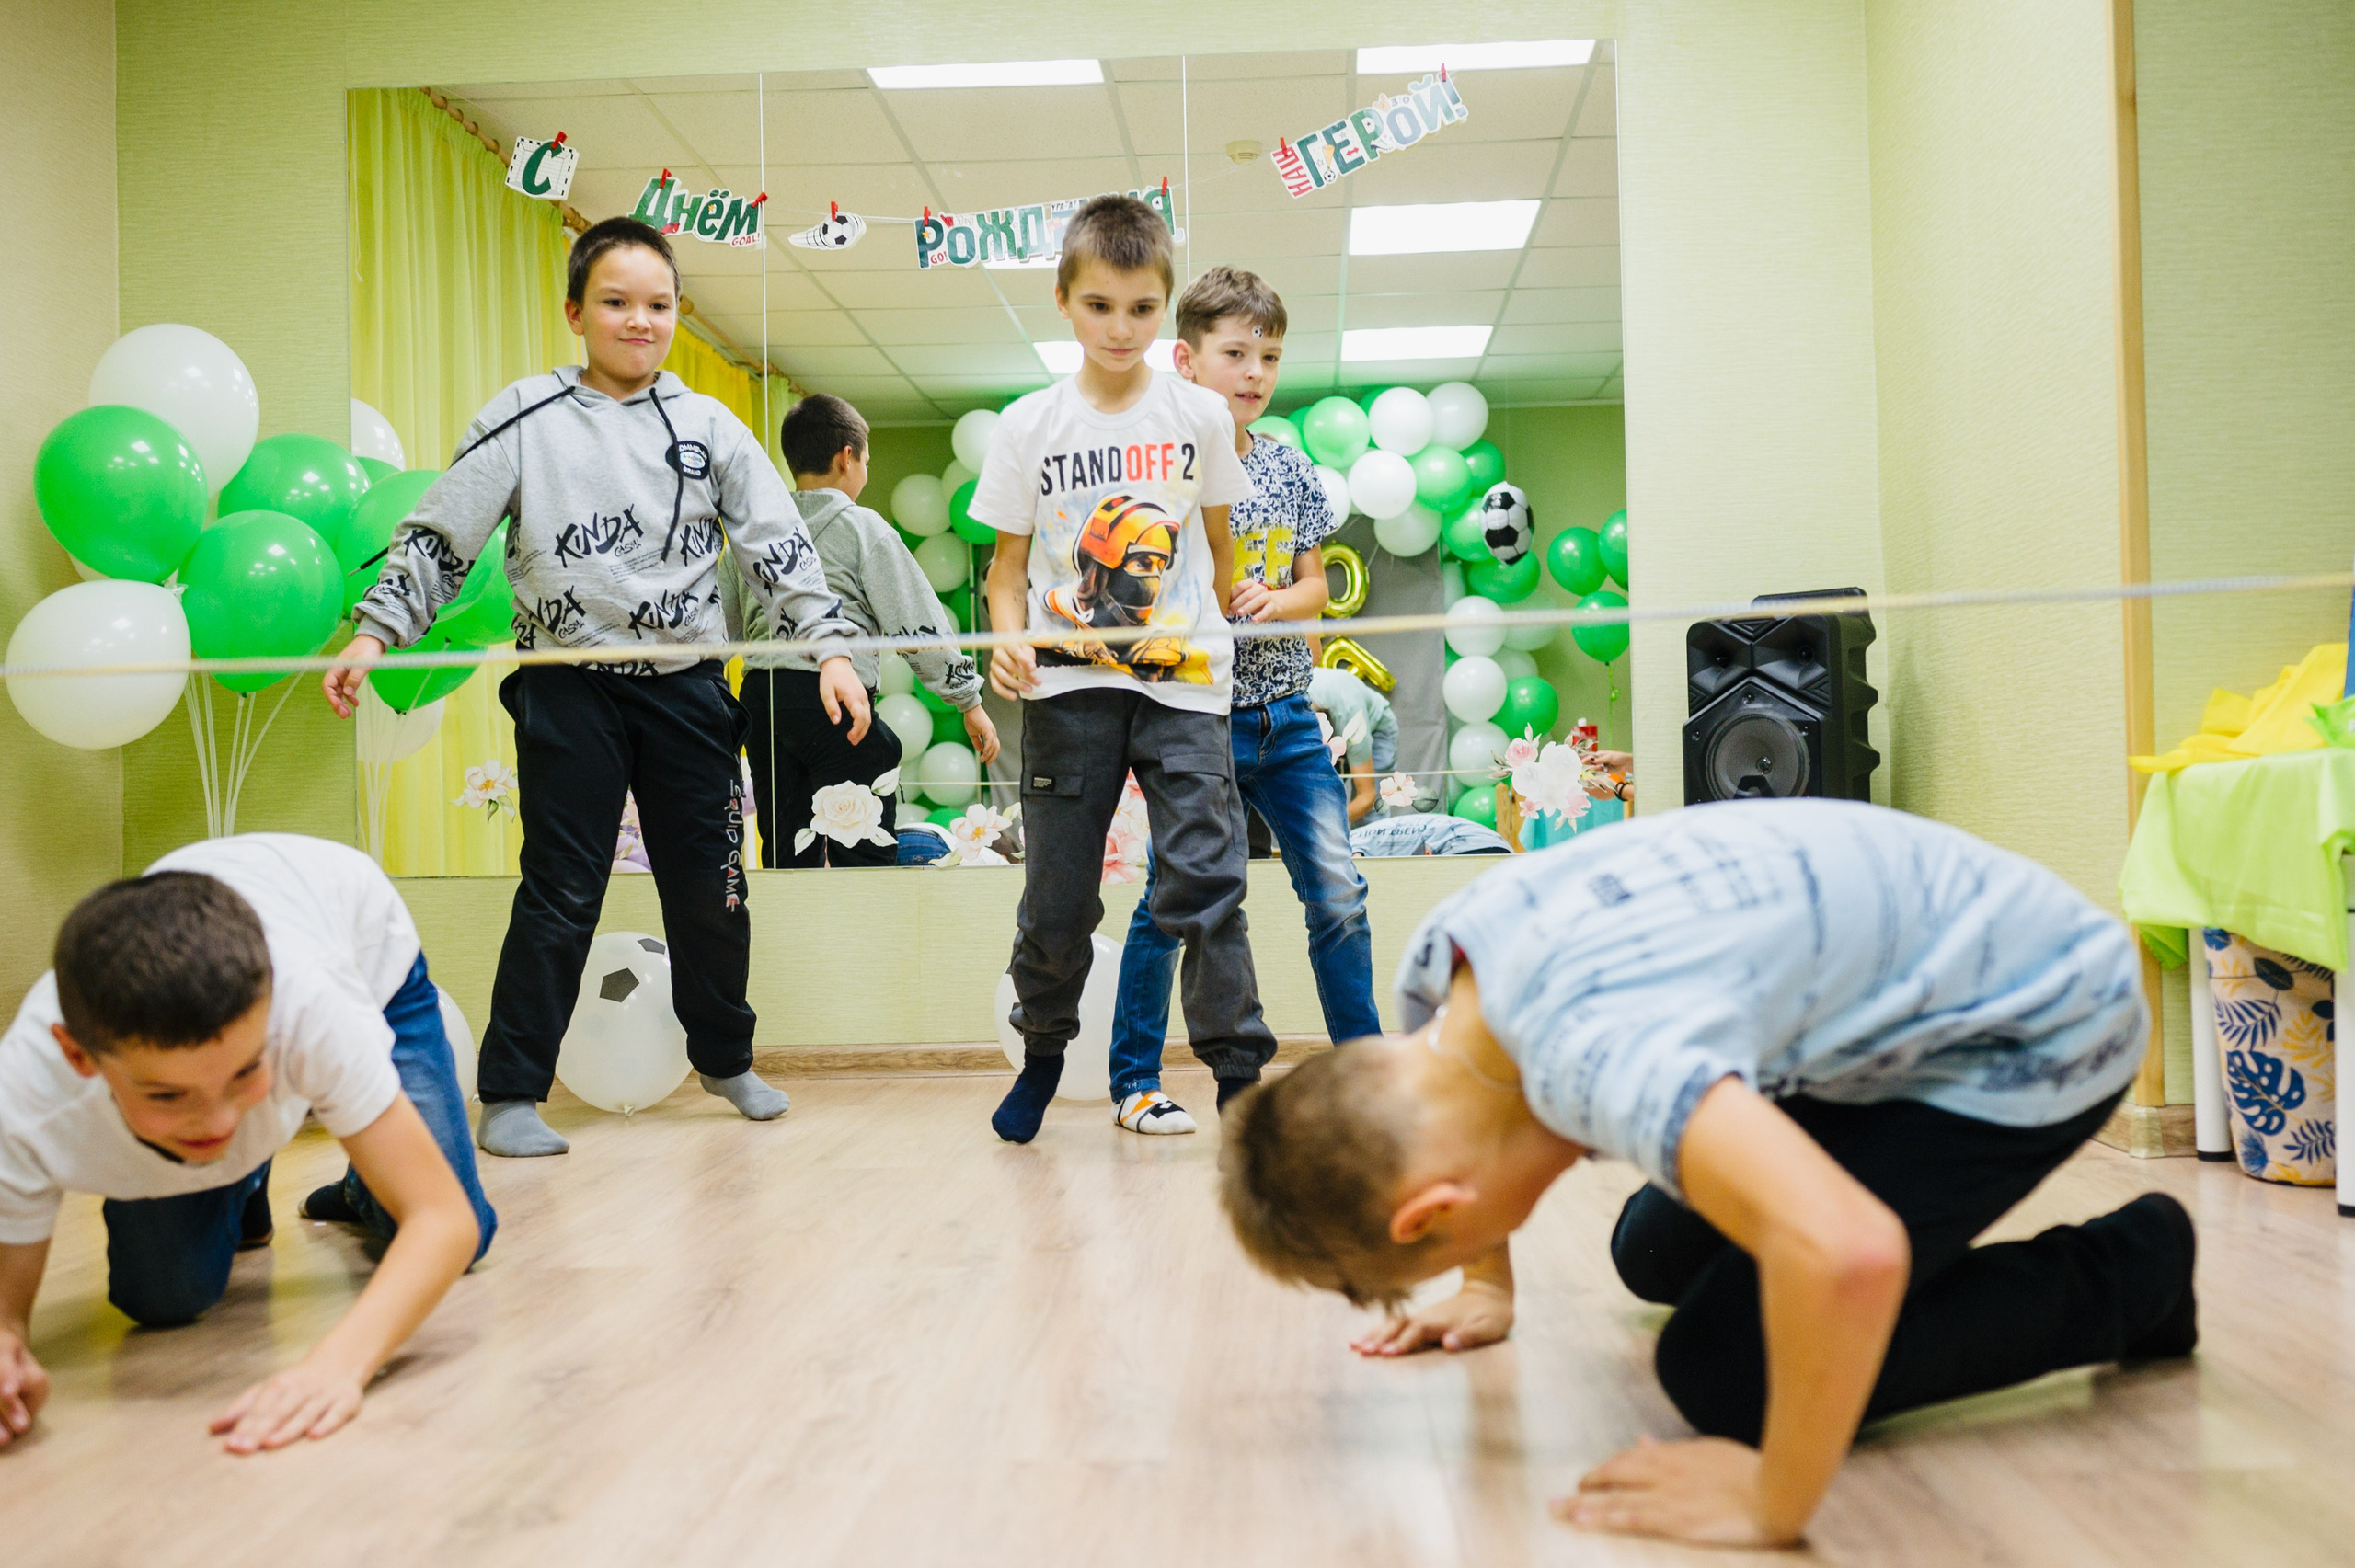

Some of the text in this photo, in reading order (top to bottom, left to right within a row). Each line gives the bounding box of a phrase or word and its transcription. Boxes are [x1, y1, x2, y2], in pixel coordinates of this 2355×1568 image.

[1272, 73, 1467, 197] НАШ ГЕРОЙ!
[522, 140, 563, 195] С
[731, 232, 761, 246] GOAL!
[930, 251, 948, 265] GO!
[1040, 442, 1195, 496] STANDOFF 2
[720, 778, 744, 913] SQUID GAME
